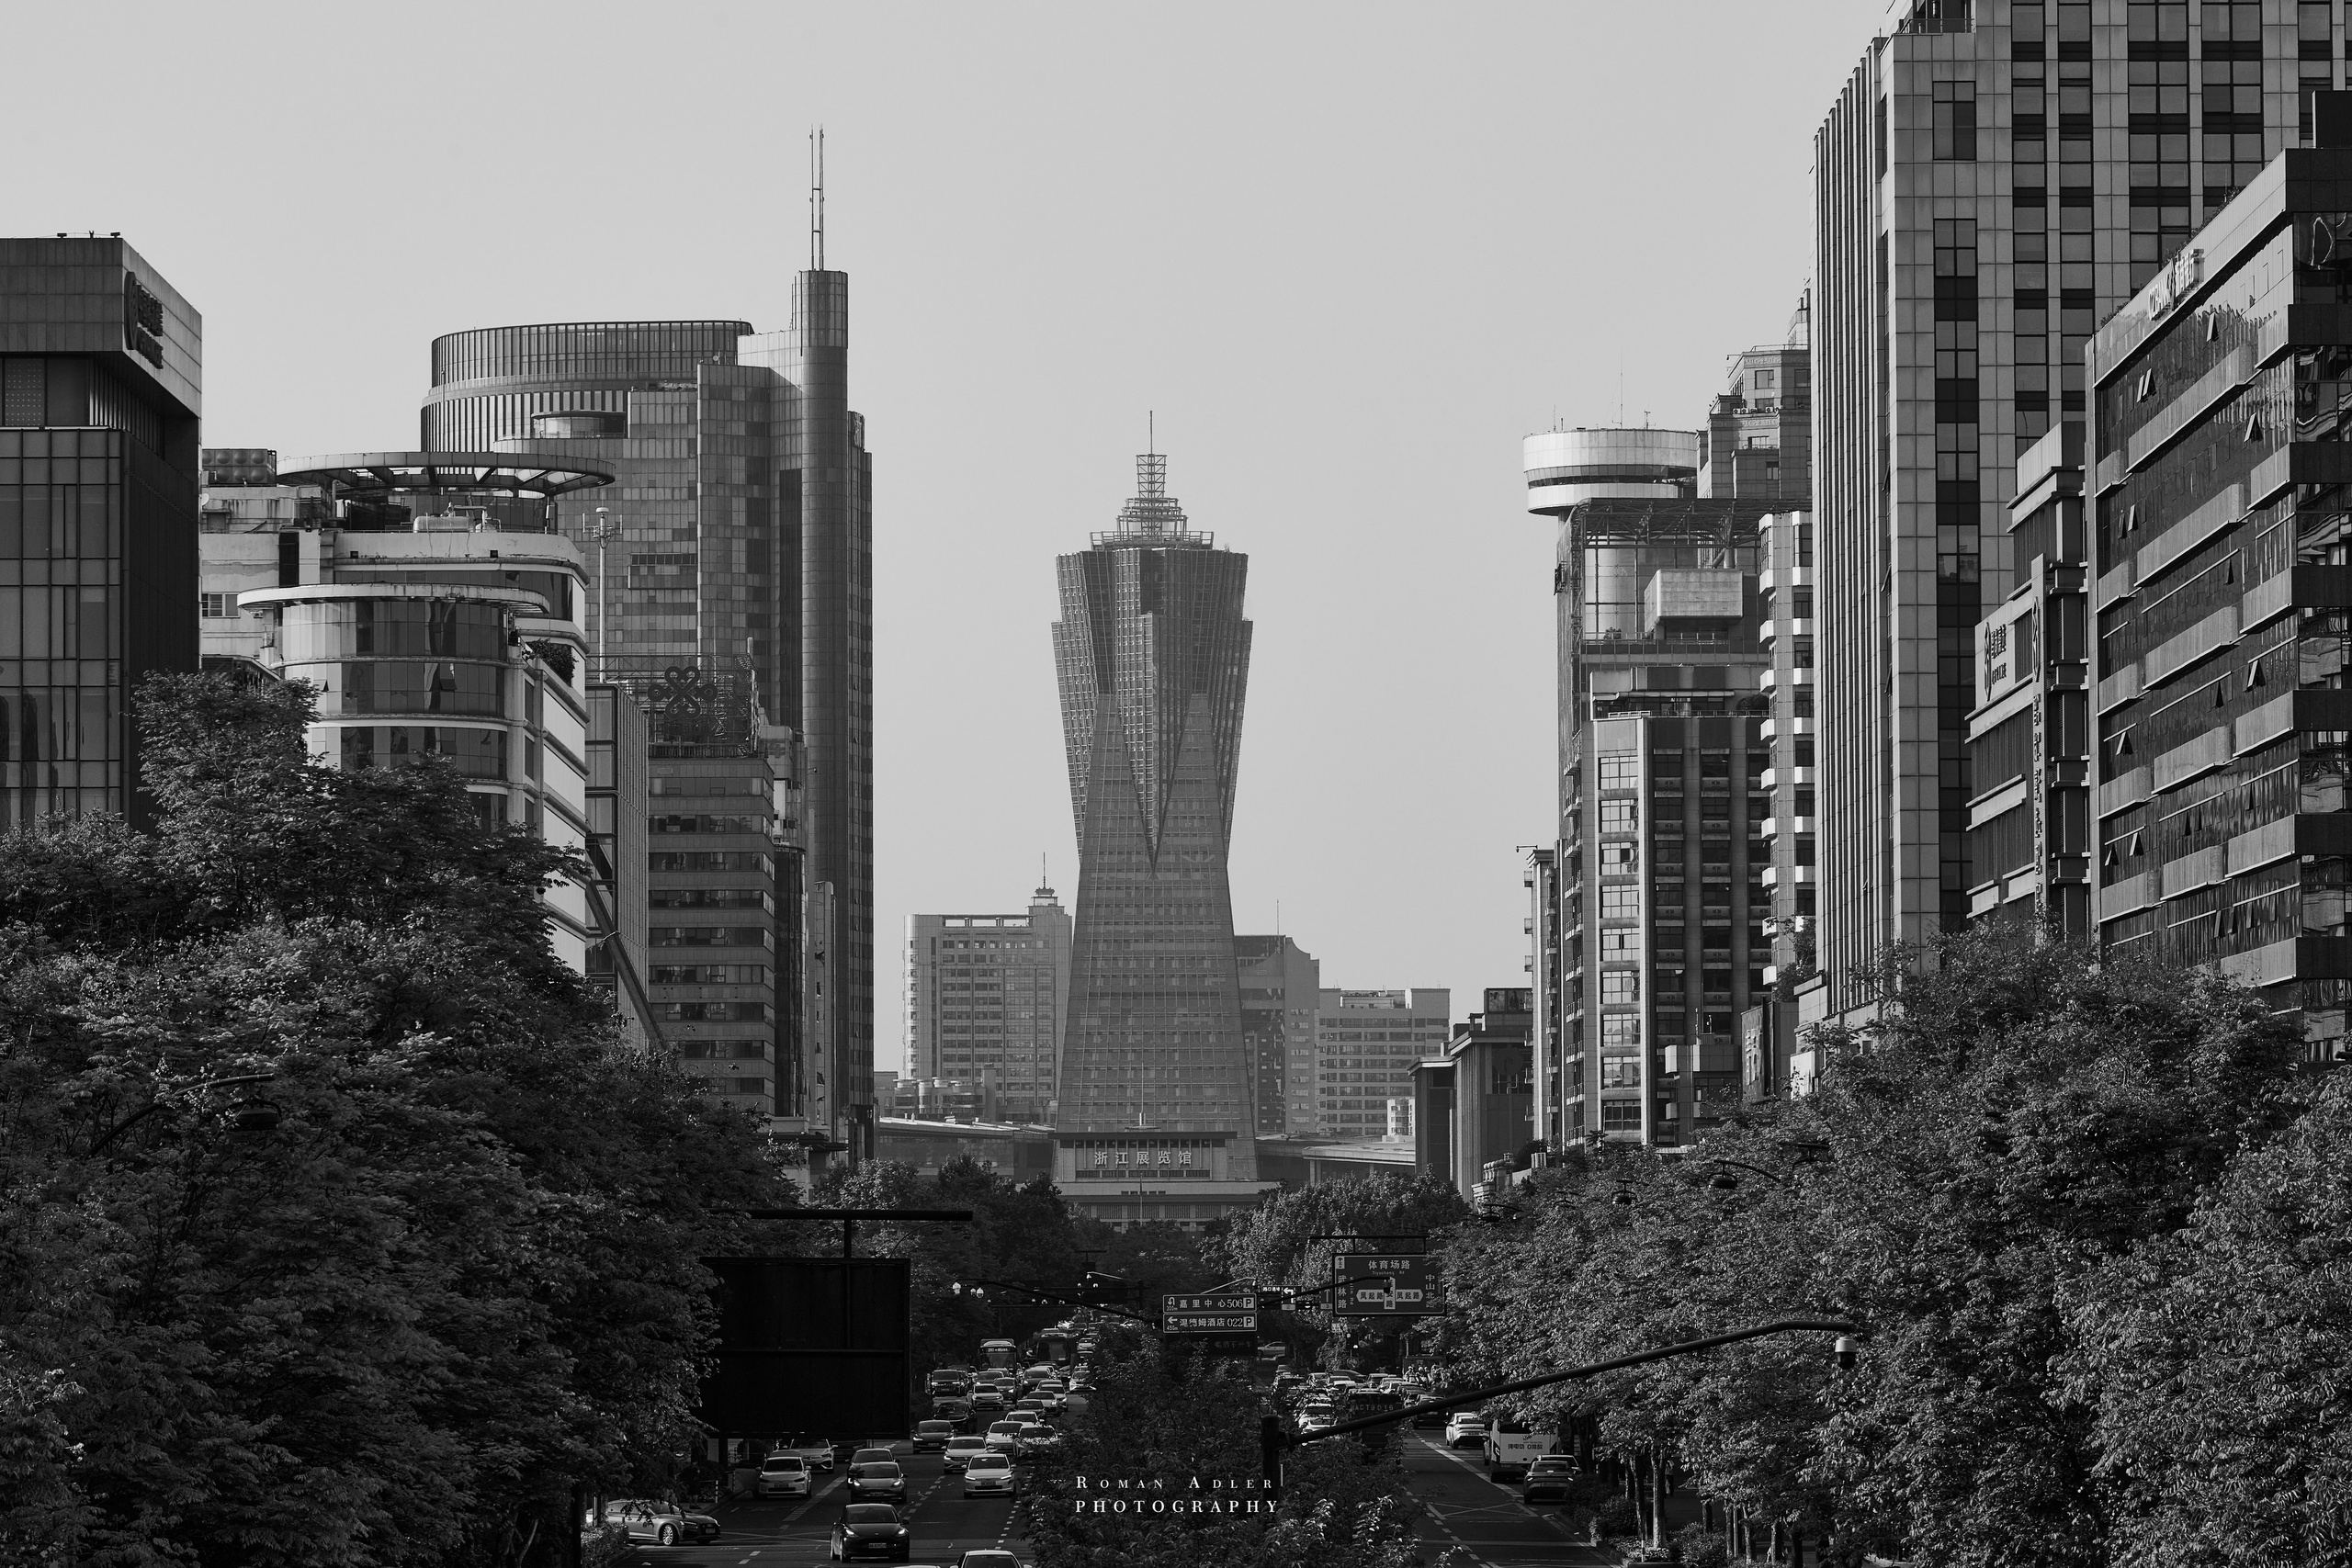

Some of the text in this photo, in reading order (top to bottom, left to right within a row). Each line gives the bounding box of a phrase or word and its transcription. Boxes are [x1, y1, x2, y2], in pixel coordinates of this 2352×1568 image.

[1094, 1151, 1192, 1165] 浙江展览馆
[1368, 1260, 1410, 1269] 体育场路
[1338, 1274, 1347, 1309] 武林路
[1179, 1298, 1227, 1309] 嘉里中心
[1227, 1298, 1243, 1309] 506
[1179, 1317, 1226, 1327] 温德姆酒店
[1227, 1317, 1243, 1327] 022
